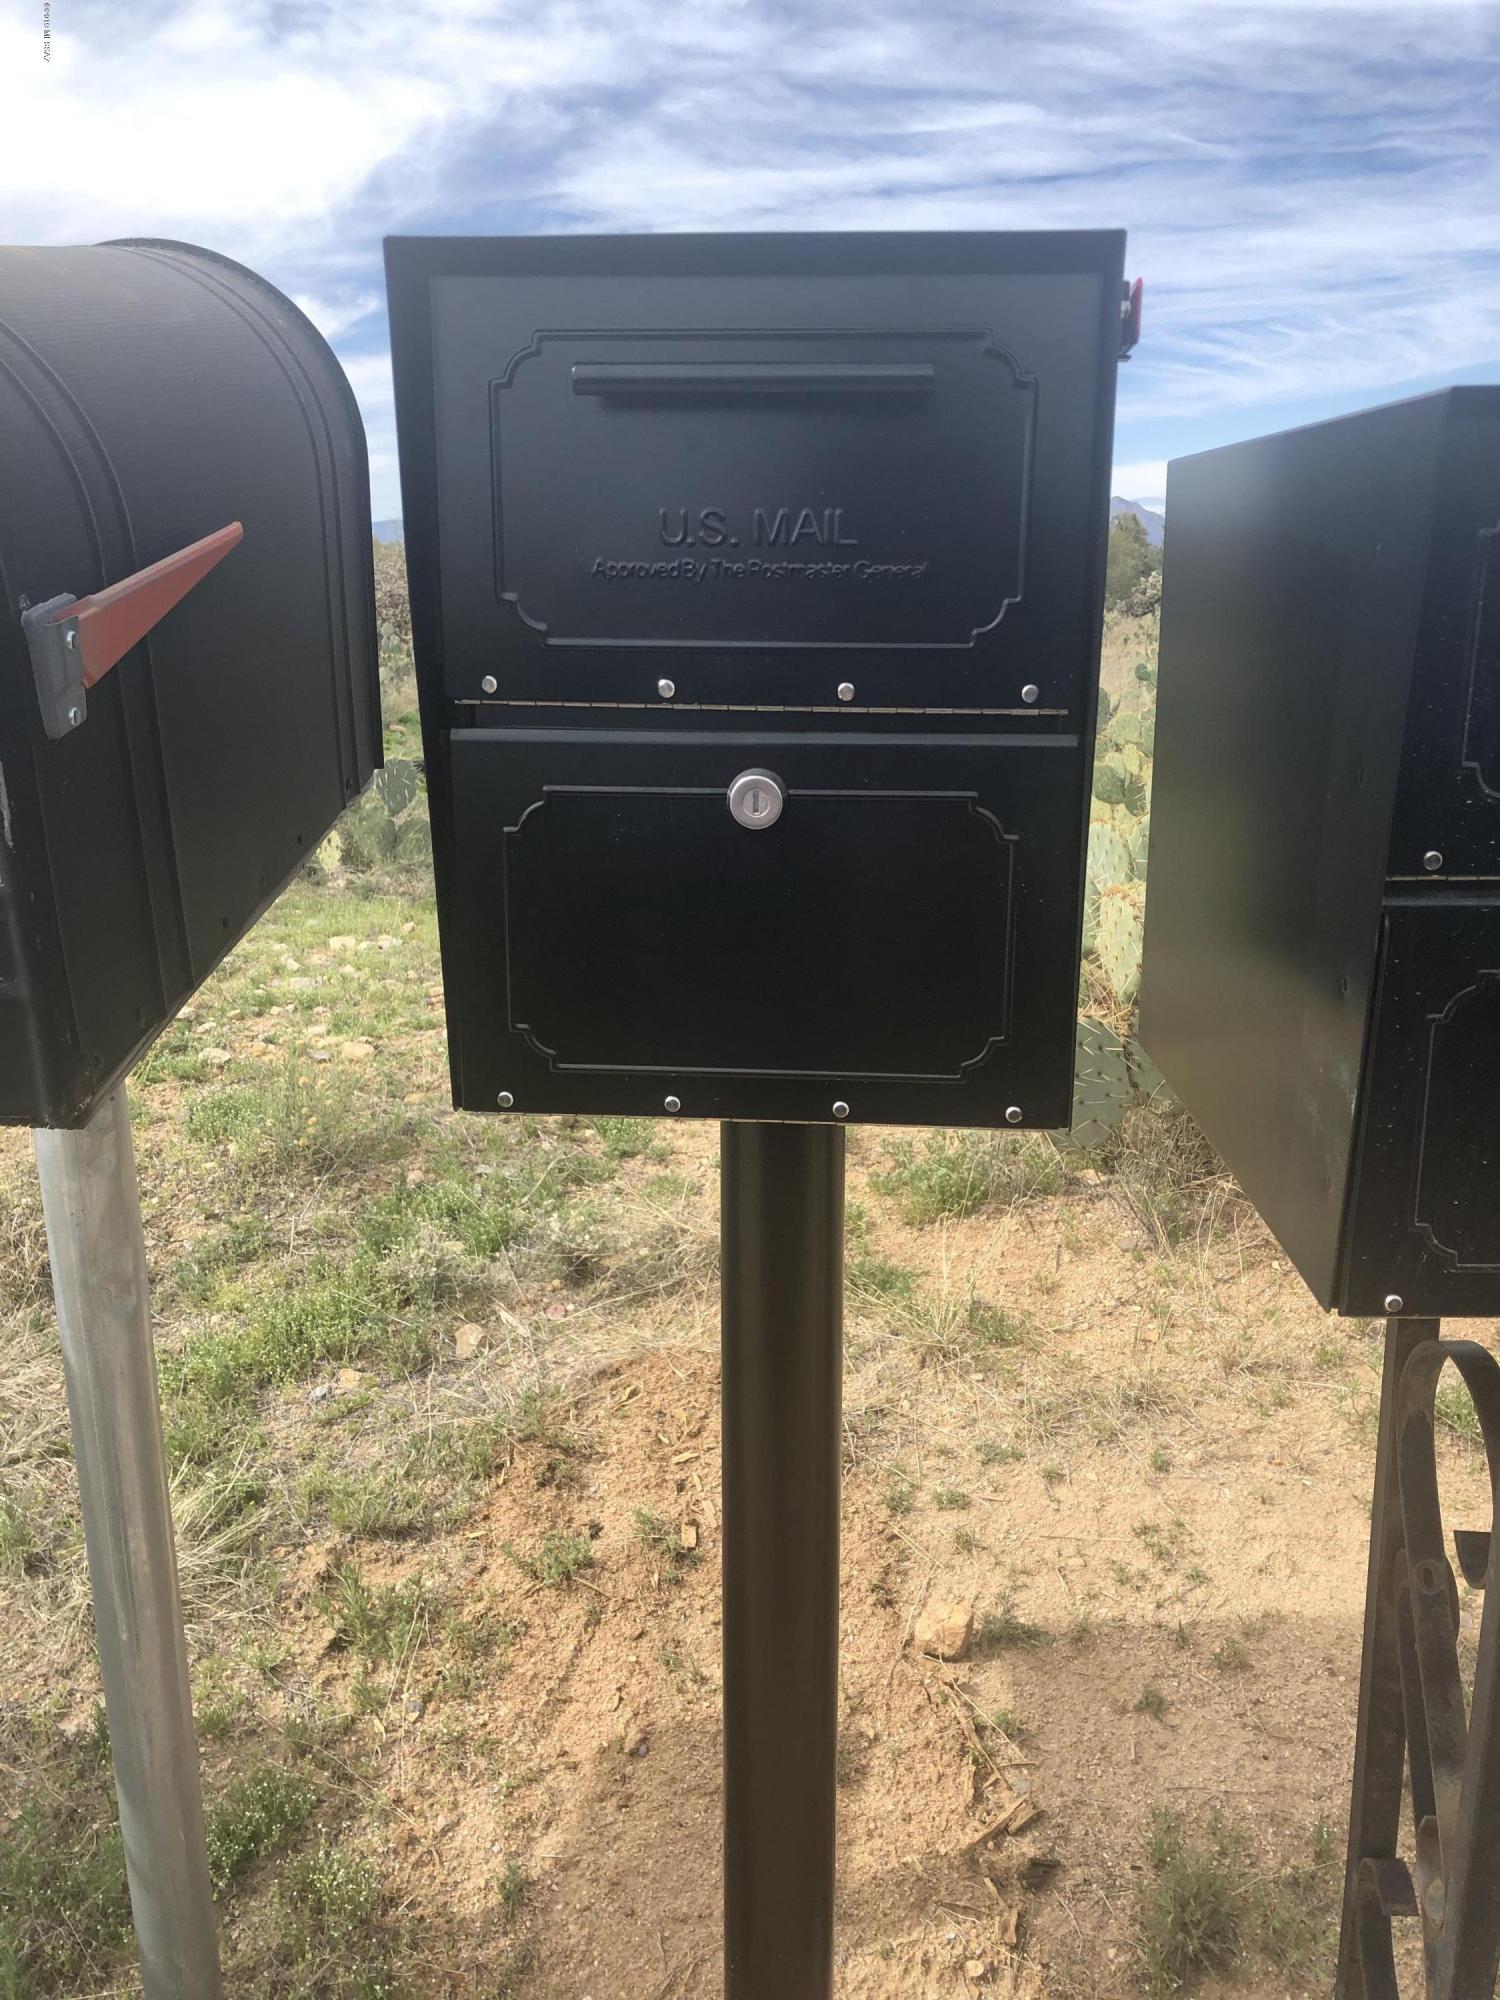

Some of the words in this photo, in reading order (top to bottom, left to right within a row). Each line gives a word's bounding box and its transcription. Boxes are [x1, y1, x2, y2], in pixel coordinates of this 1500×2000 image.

[658, 507, 739, 547] U.S.
[753, 507, 858, 546] MAIL
[711, 557, 746, 579] The
[748, 558, 851, 580] Postmaster
[854, 559, 928, 580] General
